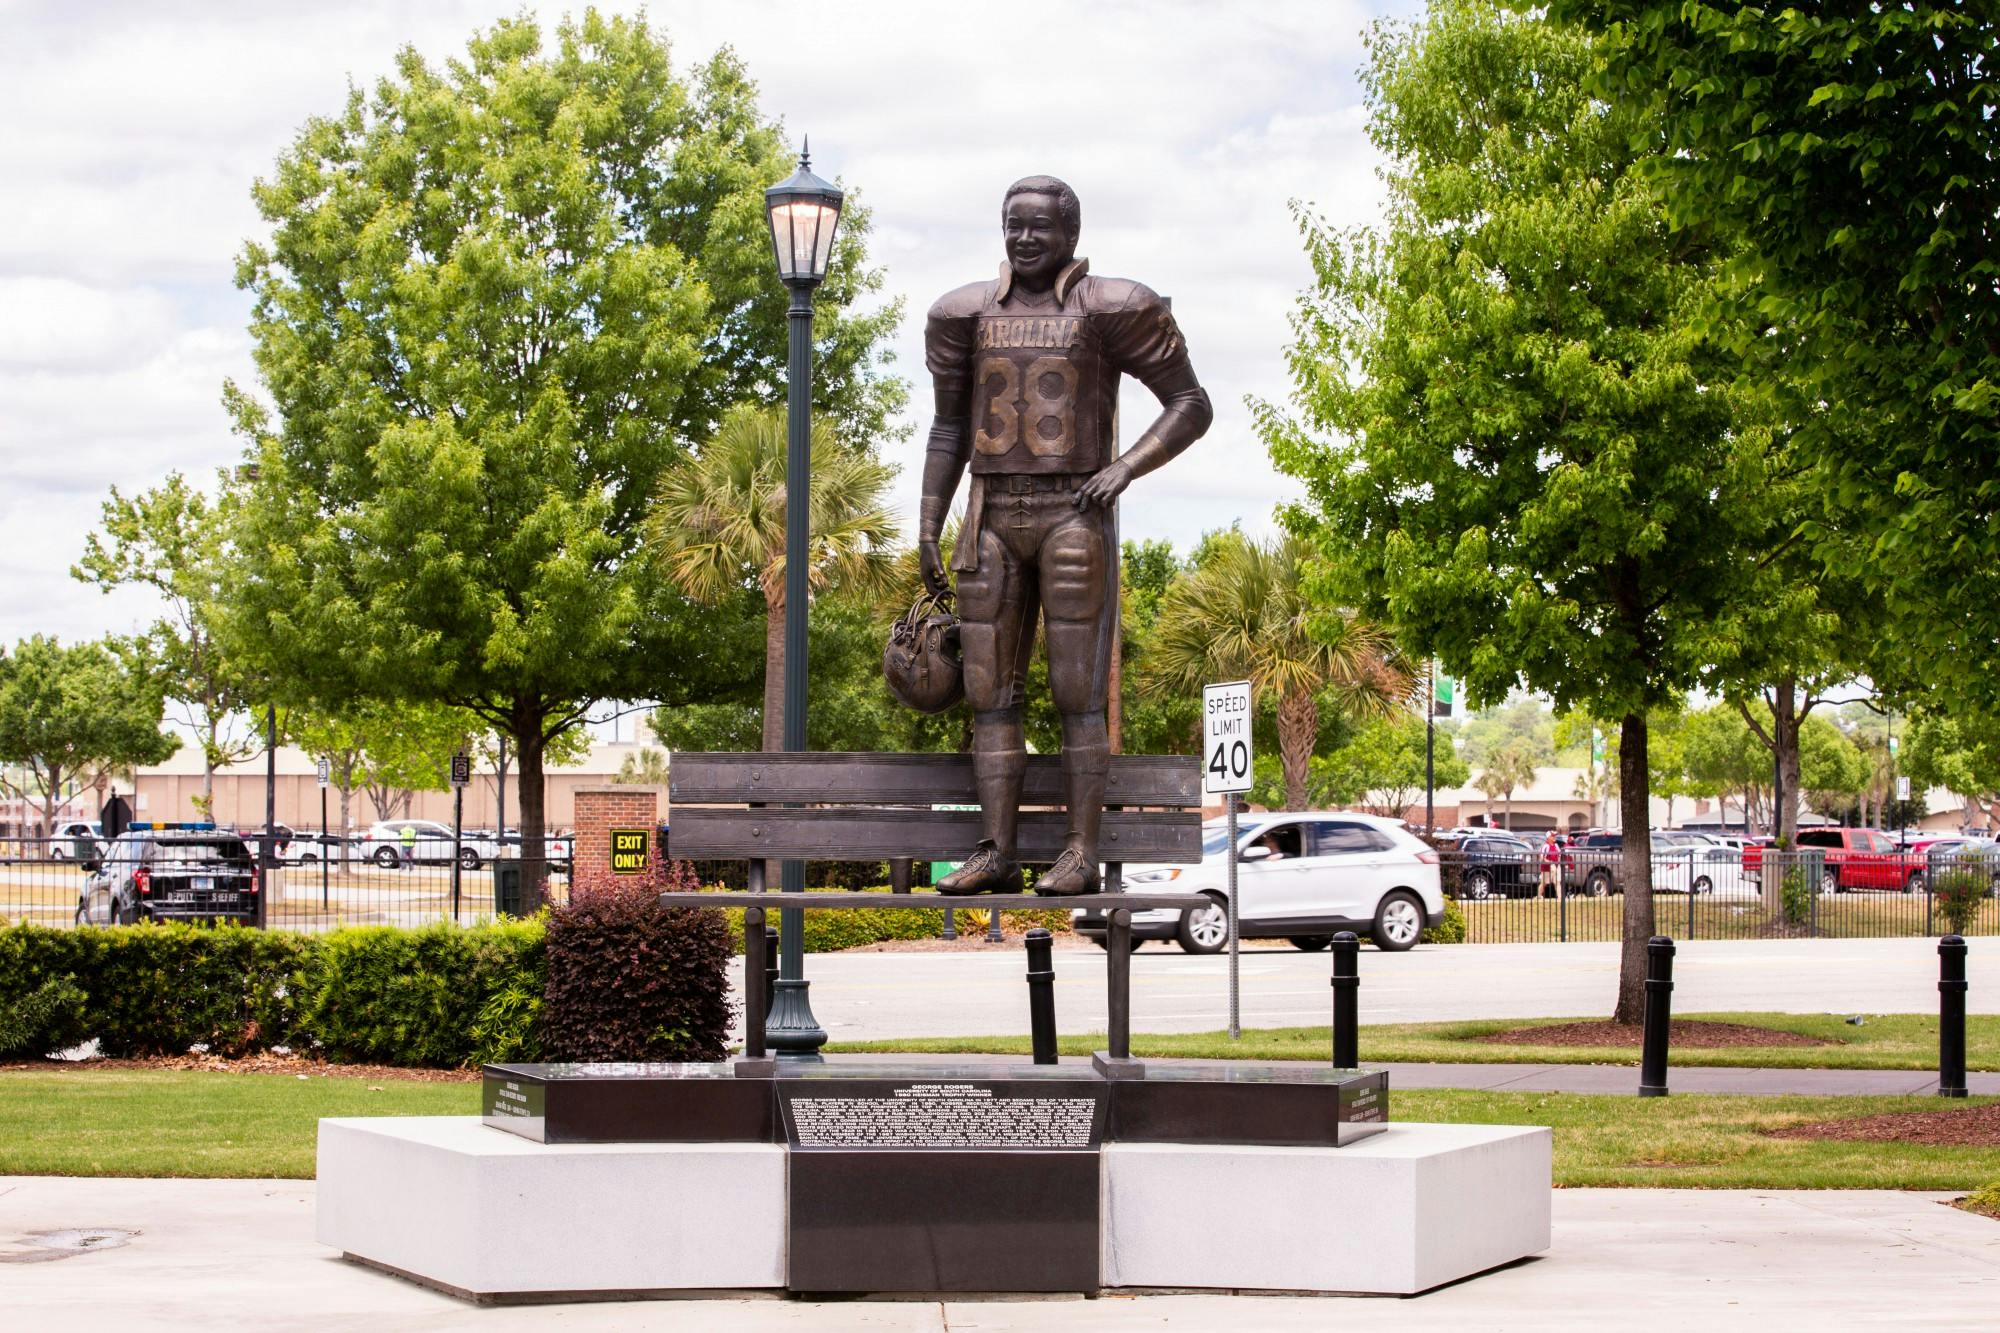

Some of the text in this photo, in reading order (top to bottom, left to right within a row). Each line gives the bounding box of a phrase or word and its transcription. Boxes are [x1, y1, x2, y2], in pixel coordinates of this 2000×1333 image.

[975, 357, 1078, 457] 38
[1208, 695, 1247, 715] SPEED
[1212, 718, 1243, 736] LIMIT
[1208, 740, 1248, 779] 40
[617, 835, 643, 849] EXIT
[614, 854, 645, 868] ONLY
